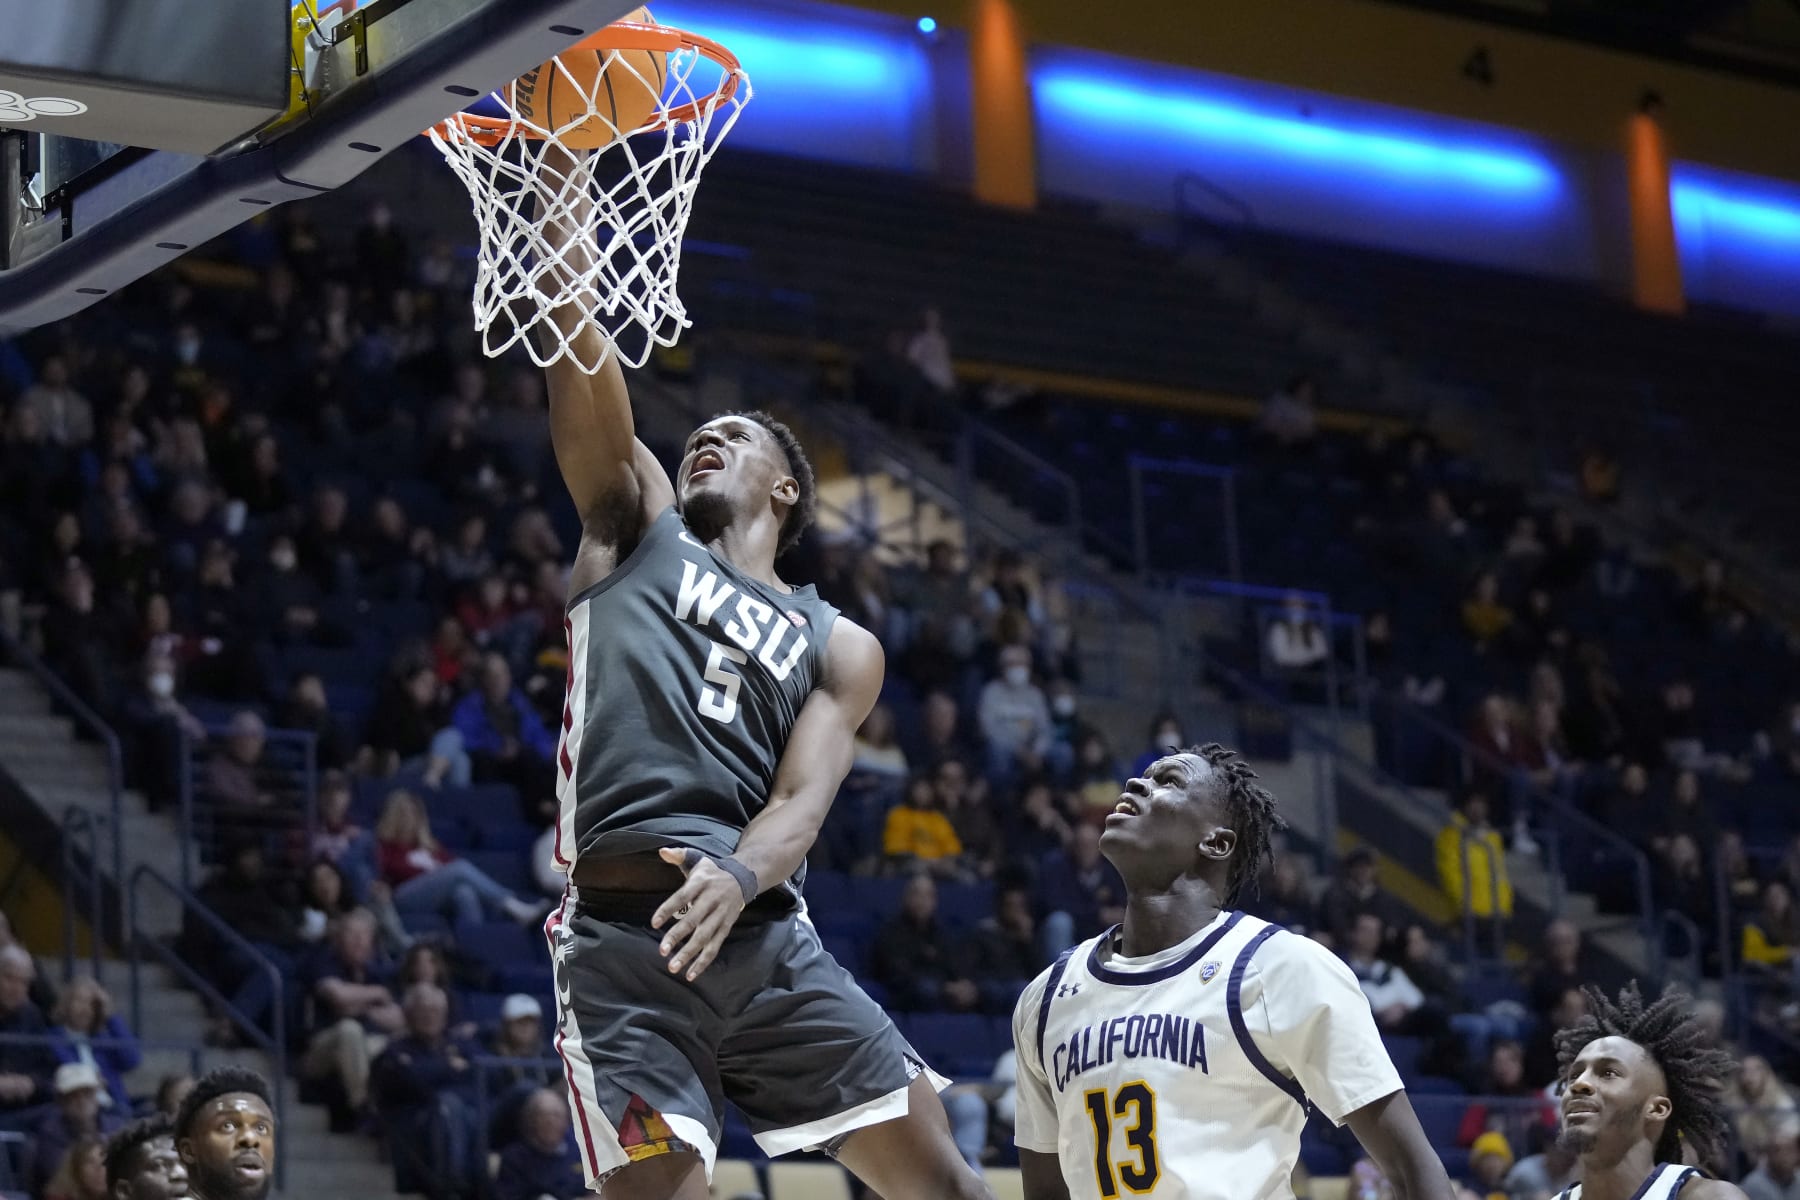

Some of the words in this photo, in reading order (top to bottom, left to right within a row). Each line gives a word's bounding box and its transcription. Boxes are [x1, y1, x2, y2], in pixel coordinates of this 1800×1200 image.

[675, 559, 809, 681] WSU
[698, 640, 748, 724] 5
[1053, 1013, 1209, 1093] CALIFORNIA
[1083, 1079, 1161, 1200] 13
